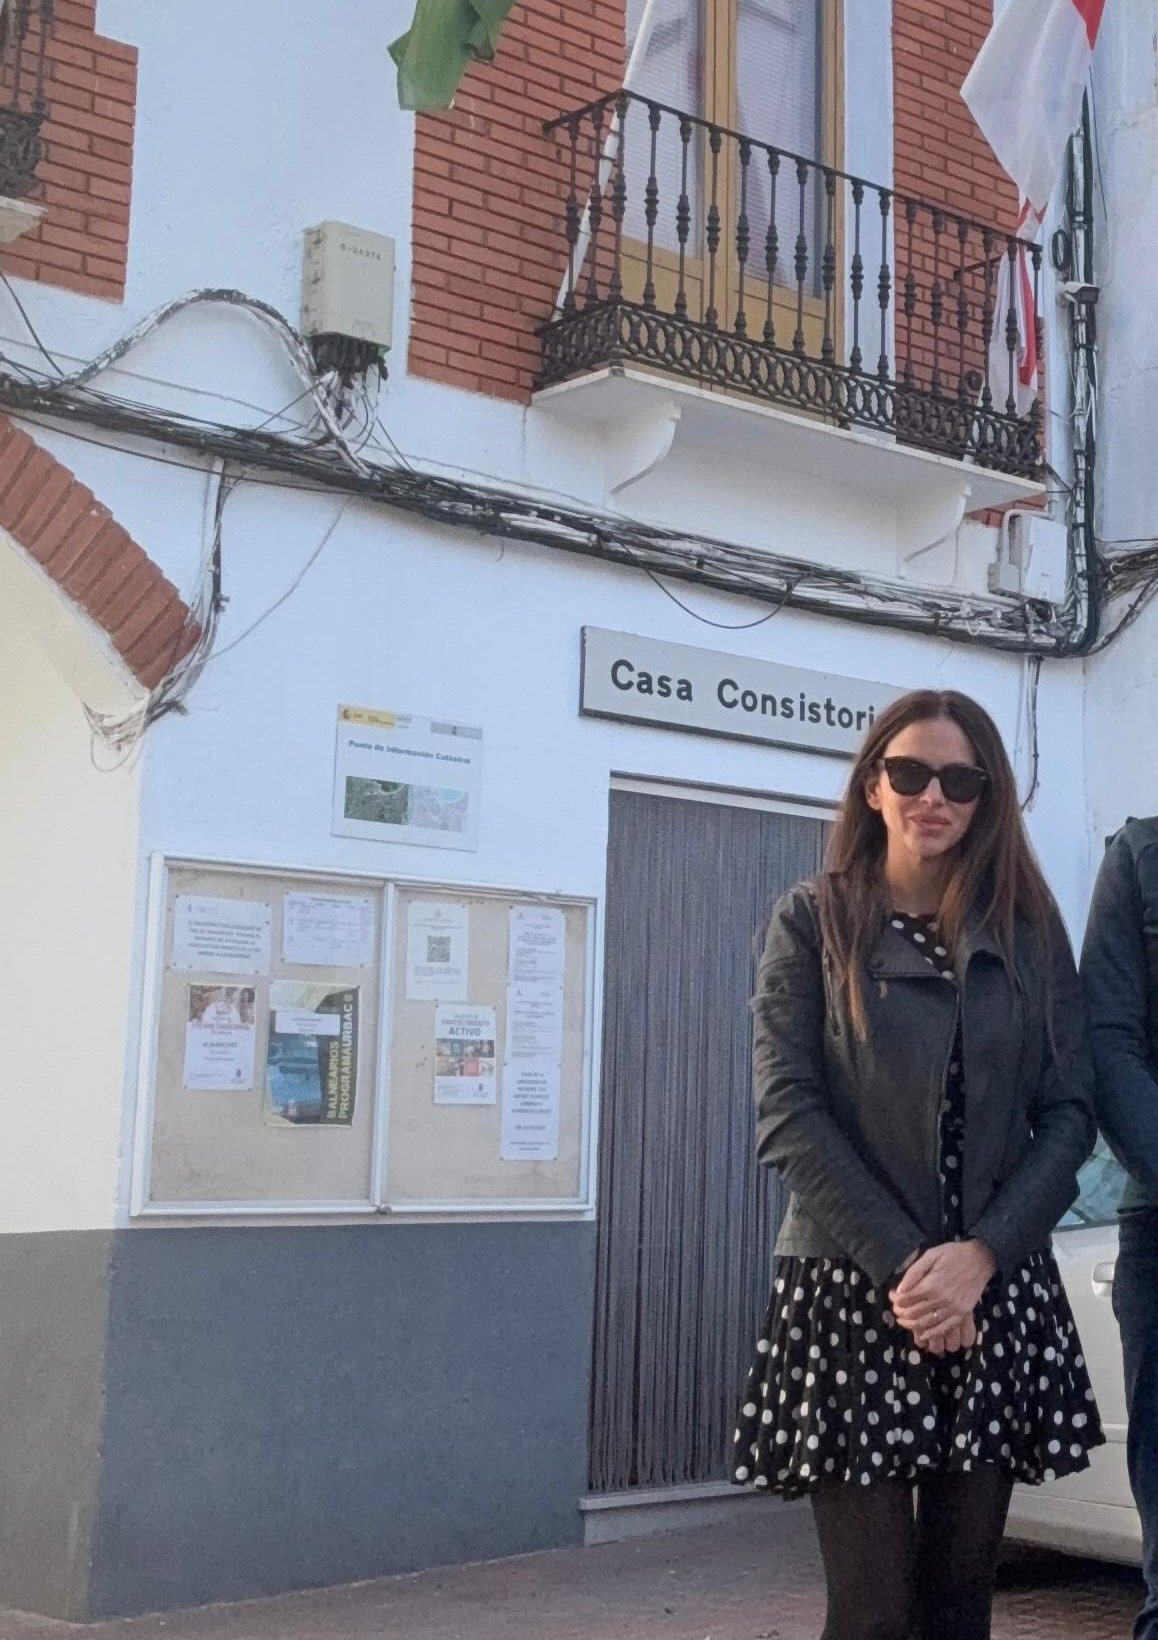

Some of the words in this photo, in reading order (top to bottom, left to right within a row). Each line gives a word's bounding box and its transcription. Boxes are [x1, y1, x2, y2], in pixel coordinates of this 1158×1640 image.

[610, 658, 693, 702] Casa
[717, 678, 875, 731] Consistori
[348, 740, 372, 750] Punto
[374, 744, 385, 752] de
[435, 753, 472, 765] Catastral
[448, 1026, 482, 1037] ACTIVO
[326, 1041, 340, 1119] BALNEARIOS
